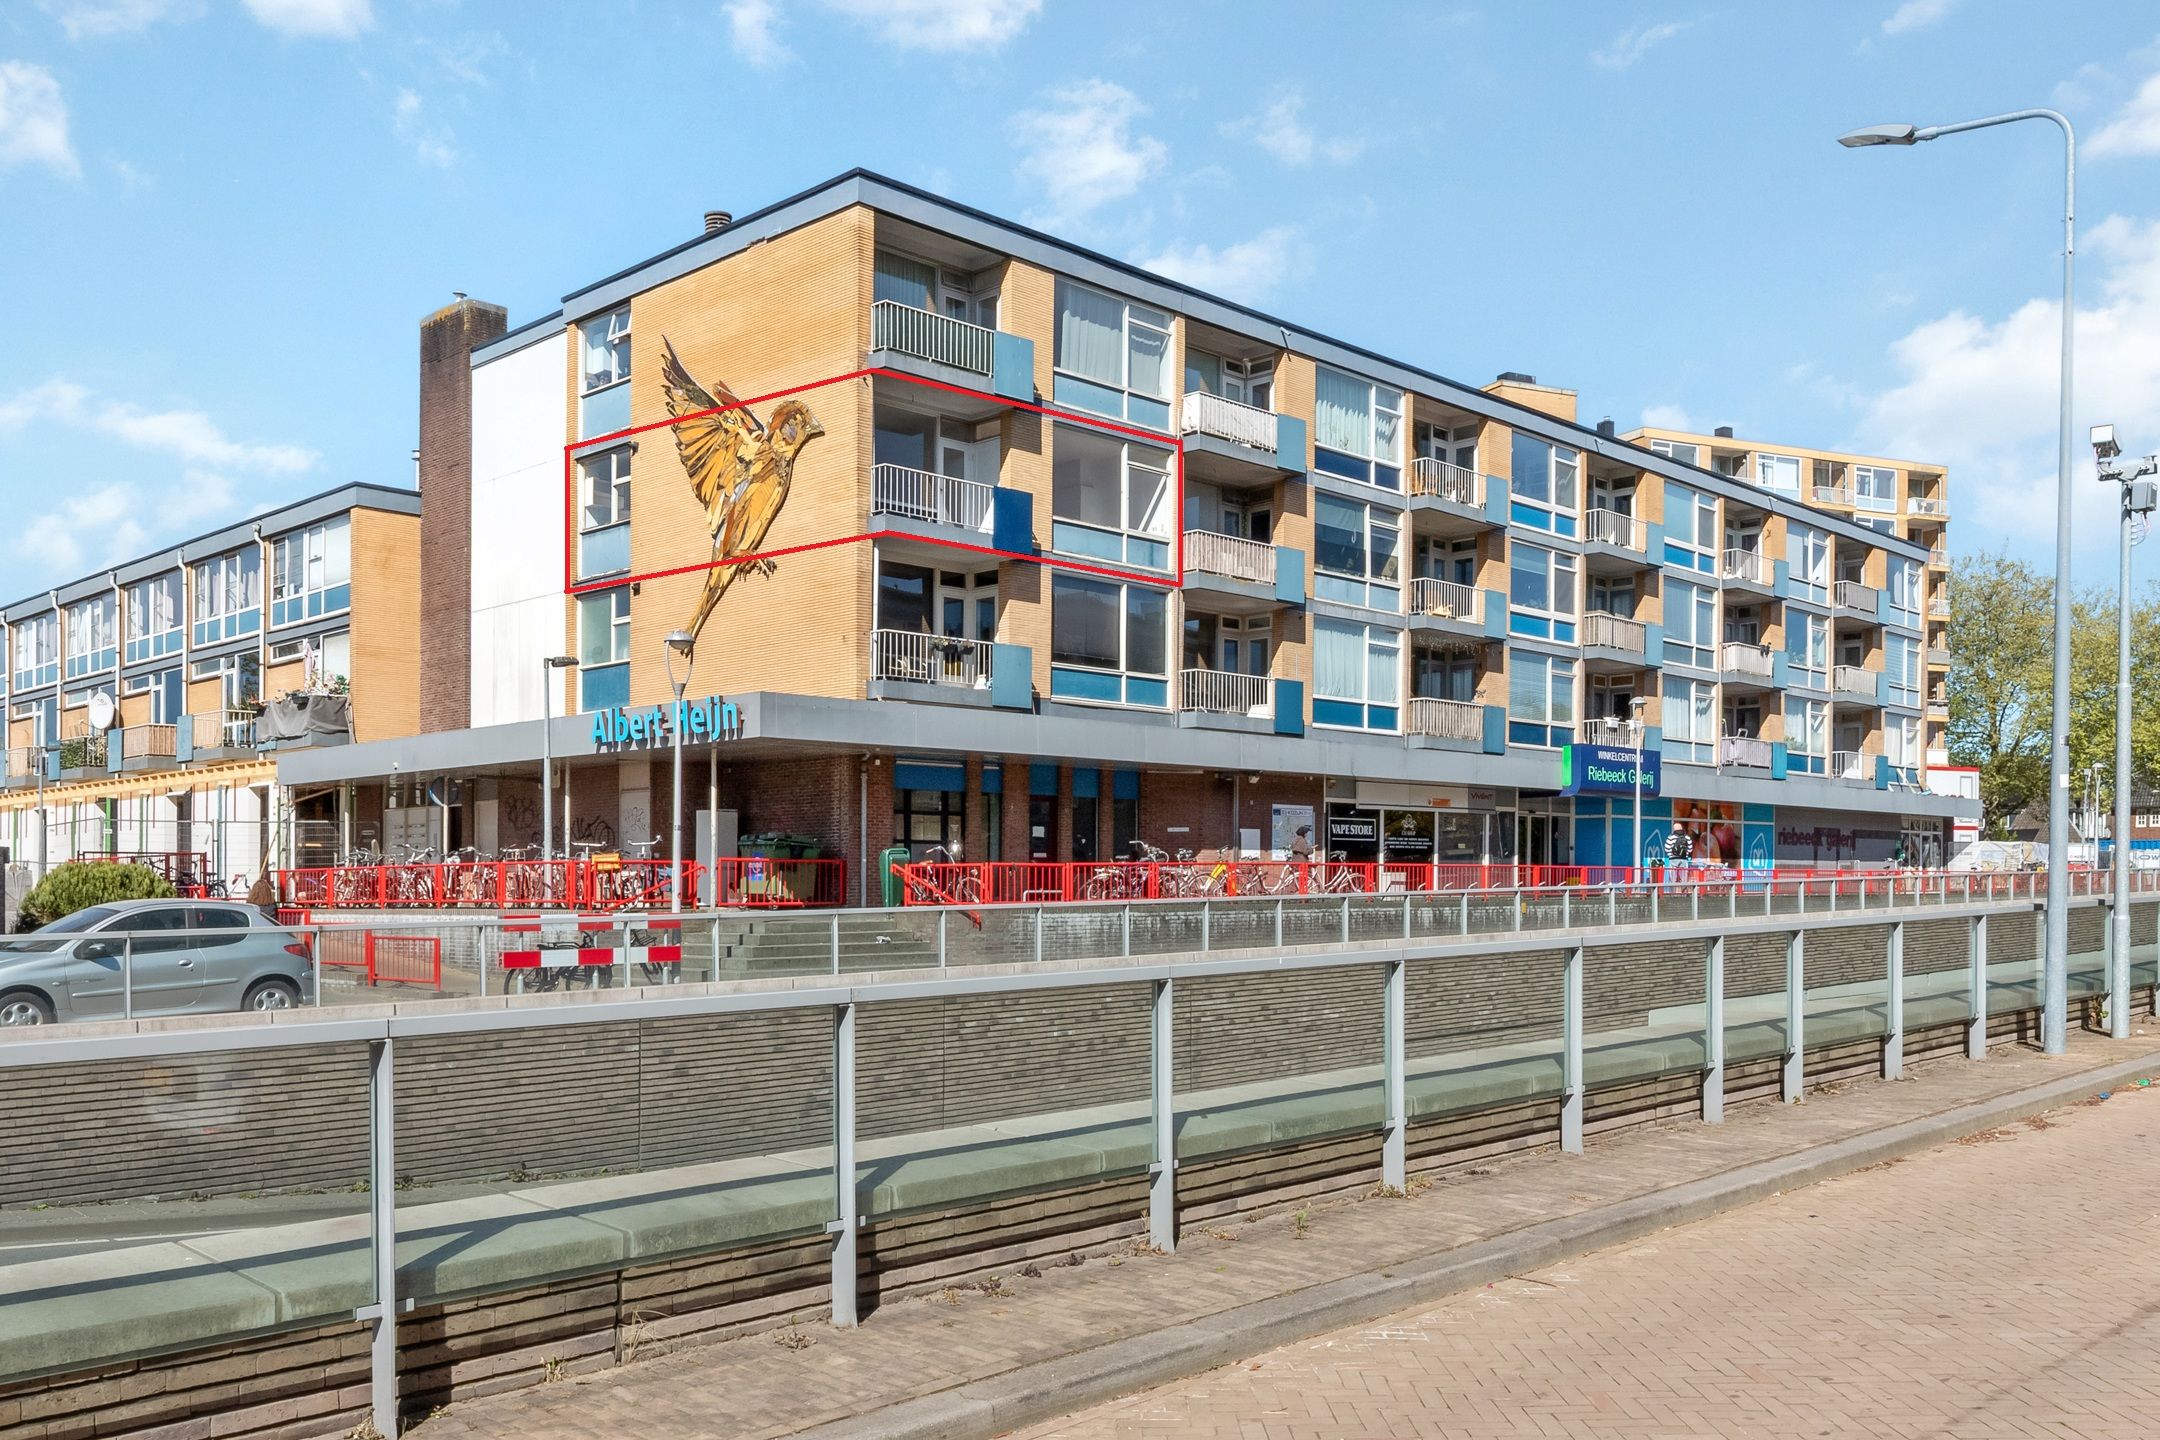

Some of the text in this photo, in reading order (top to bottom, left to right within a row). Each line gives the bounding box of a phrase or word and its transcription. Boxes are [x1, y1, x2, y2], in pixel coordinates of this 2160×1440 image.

[591, 695, 738, 744] Albert Heijn
[1588, 766, 1654, 789] Riebeeck Glerij
[1331, 824, 1373, 836] VAPE STORE
